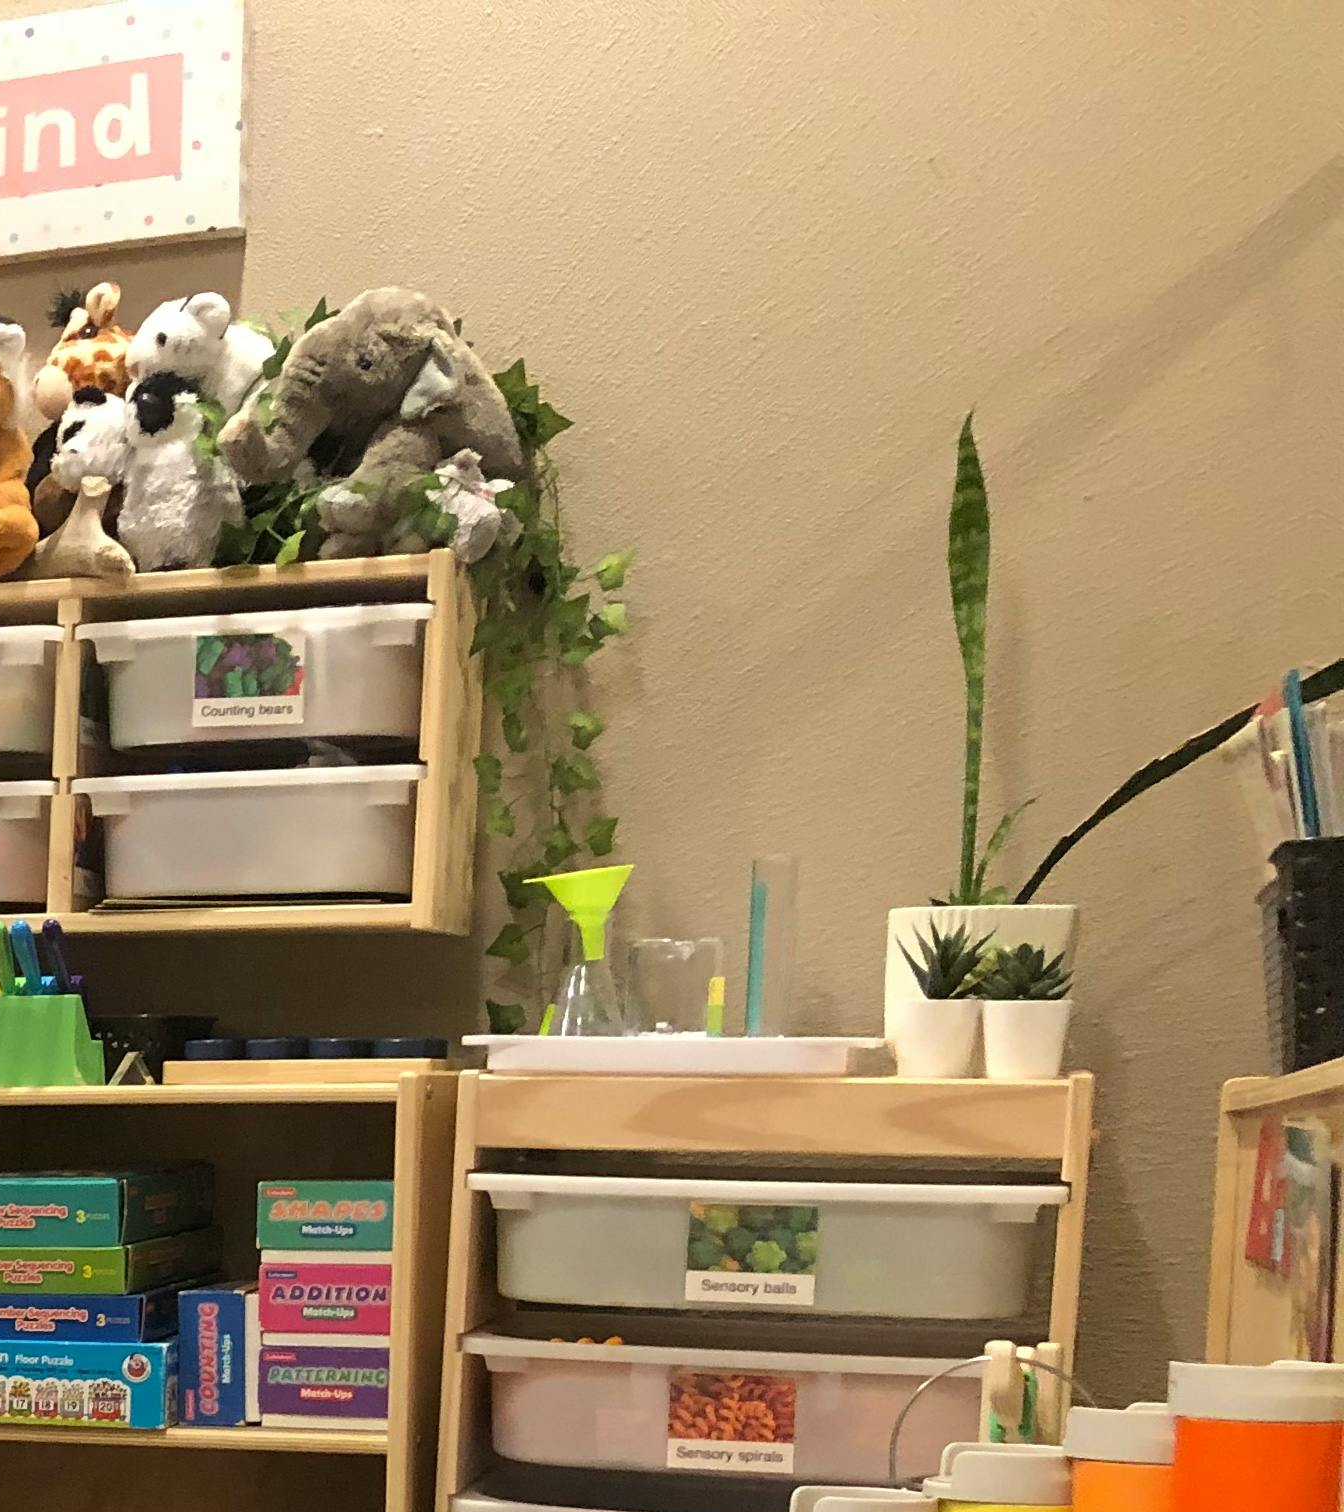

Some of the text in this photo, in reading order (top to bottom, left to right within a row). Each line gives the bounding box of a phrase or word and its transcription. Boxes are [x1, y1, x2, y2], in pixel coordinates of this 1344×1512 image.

[200, 702, 294, 720] Counting bears
[7, 1204, 68, 1219] Sequencing
[75, 1209, 86, 1224] 3
[270, 1201, 387, 1221] SHAPES
[301, 1225, 354, 1237] Match-Ups
[15, 1260, 75, 1275] Sequencing
[82, 1264, 93, 1279] 3
[3, 1272, 43, 1284] Puzzles
[270, 1285, 388, 1304] ADDITION
[701, 1279, 798, 1297] Sensory balls
[26, 1307, 88, 1322] Sequencing
[95, 1313, 107, 1327] 3
[302, 1307, 355, 1319] Match-Ups
[15, 1320, 56, 1333] Puzzles
[14, 1354, 38, 1365] Floor
[41, 1355, 74, 1367] Puzzle
[198, 1303, 219, 1415] COUNTING
[221, 1333, 234, 1384] Match-Ups
[268, 1366, 388, 1385] PATTERNING
[300, 1388, 353, 1400] Match-Ups
[14, 1399, 26, 1409] 17
[100, 1402, 113, 1412] 20
[675, 1446, 784, 1466] Sensory spirals
